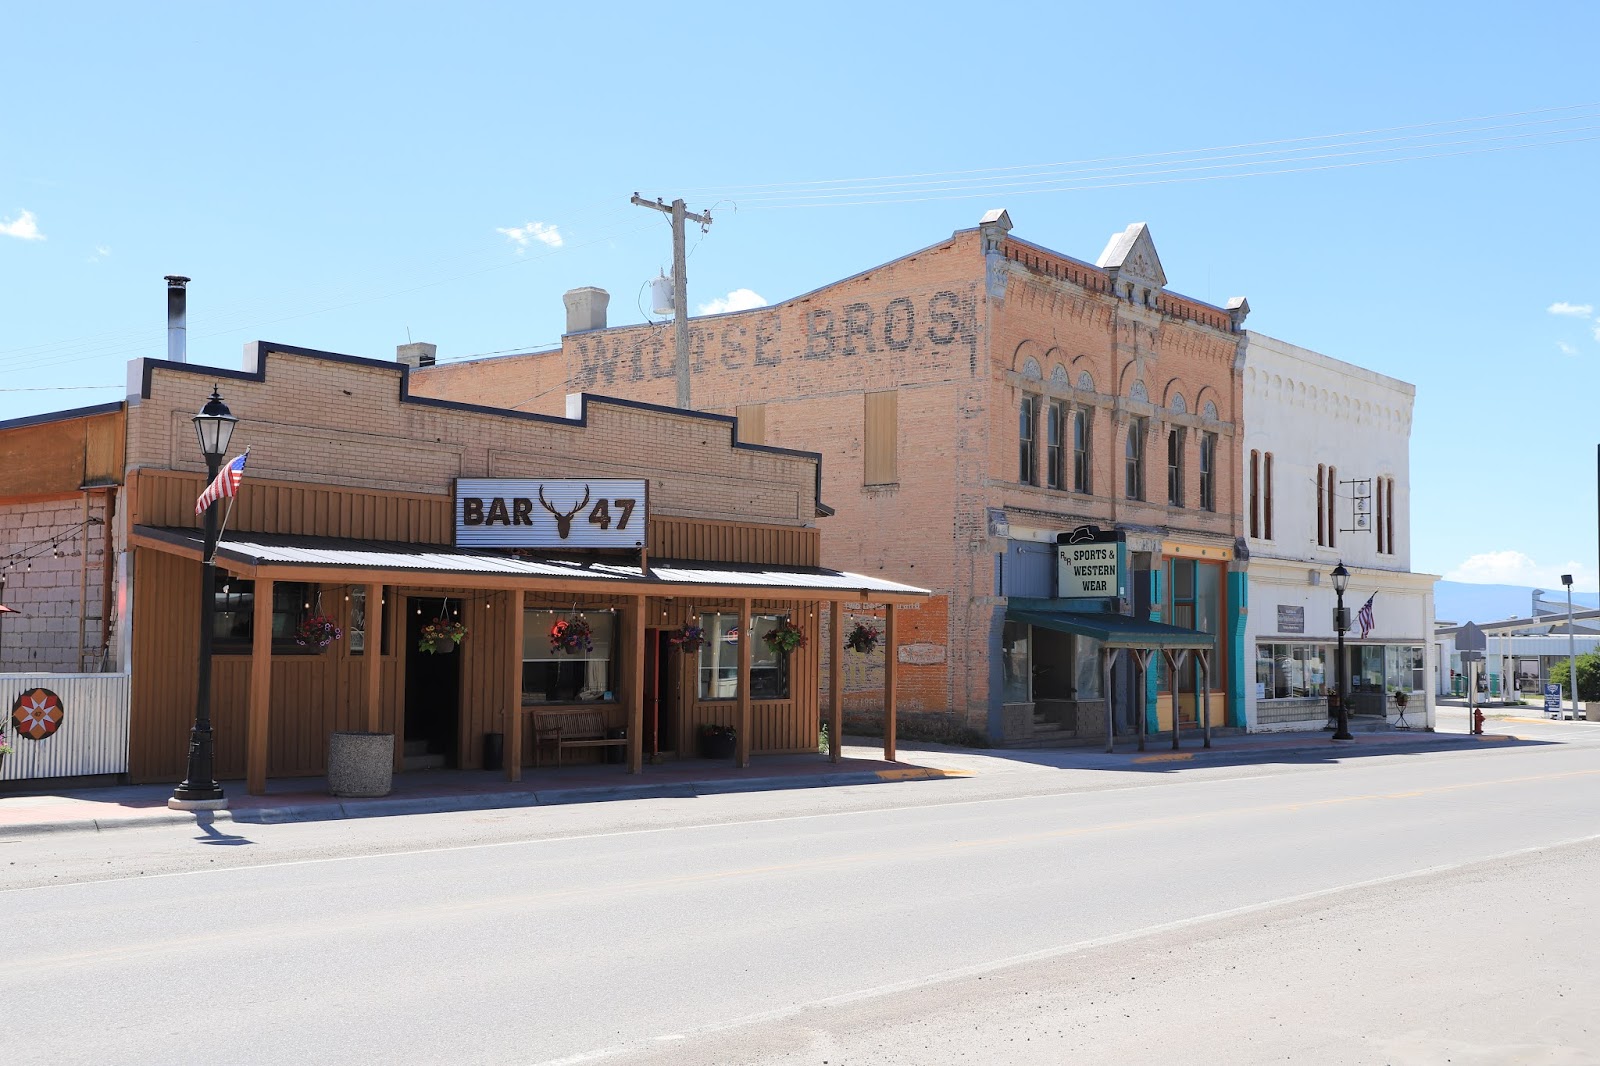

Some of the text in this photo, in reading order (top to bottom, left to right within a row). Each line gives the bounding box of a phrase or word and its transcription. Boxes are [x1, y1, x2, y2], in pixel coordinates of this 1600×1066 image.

[804, 291, 960, 361] BROS
[463, 498, 636, 530] BAR 47
[1074, 549, 1115, 561] SPORTS &
[1073, 565, 1115, 576] WESTERN
[1082, 581, 1107, 591] WEAR
